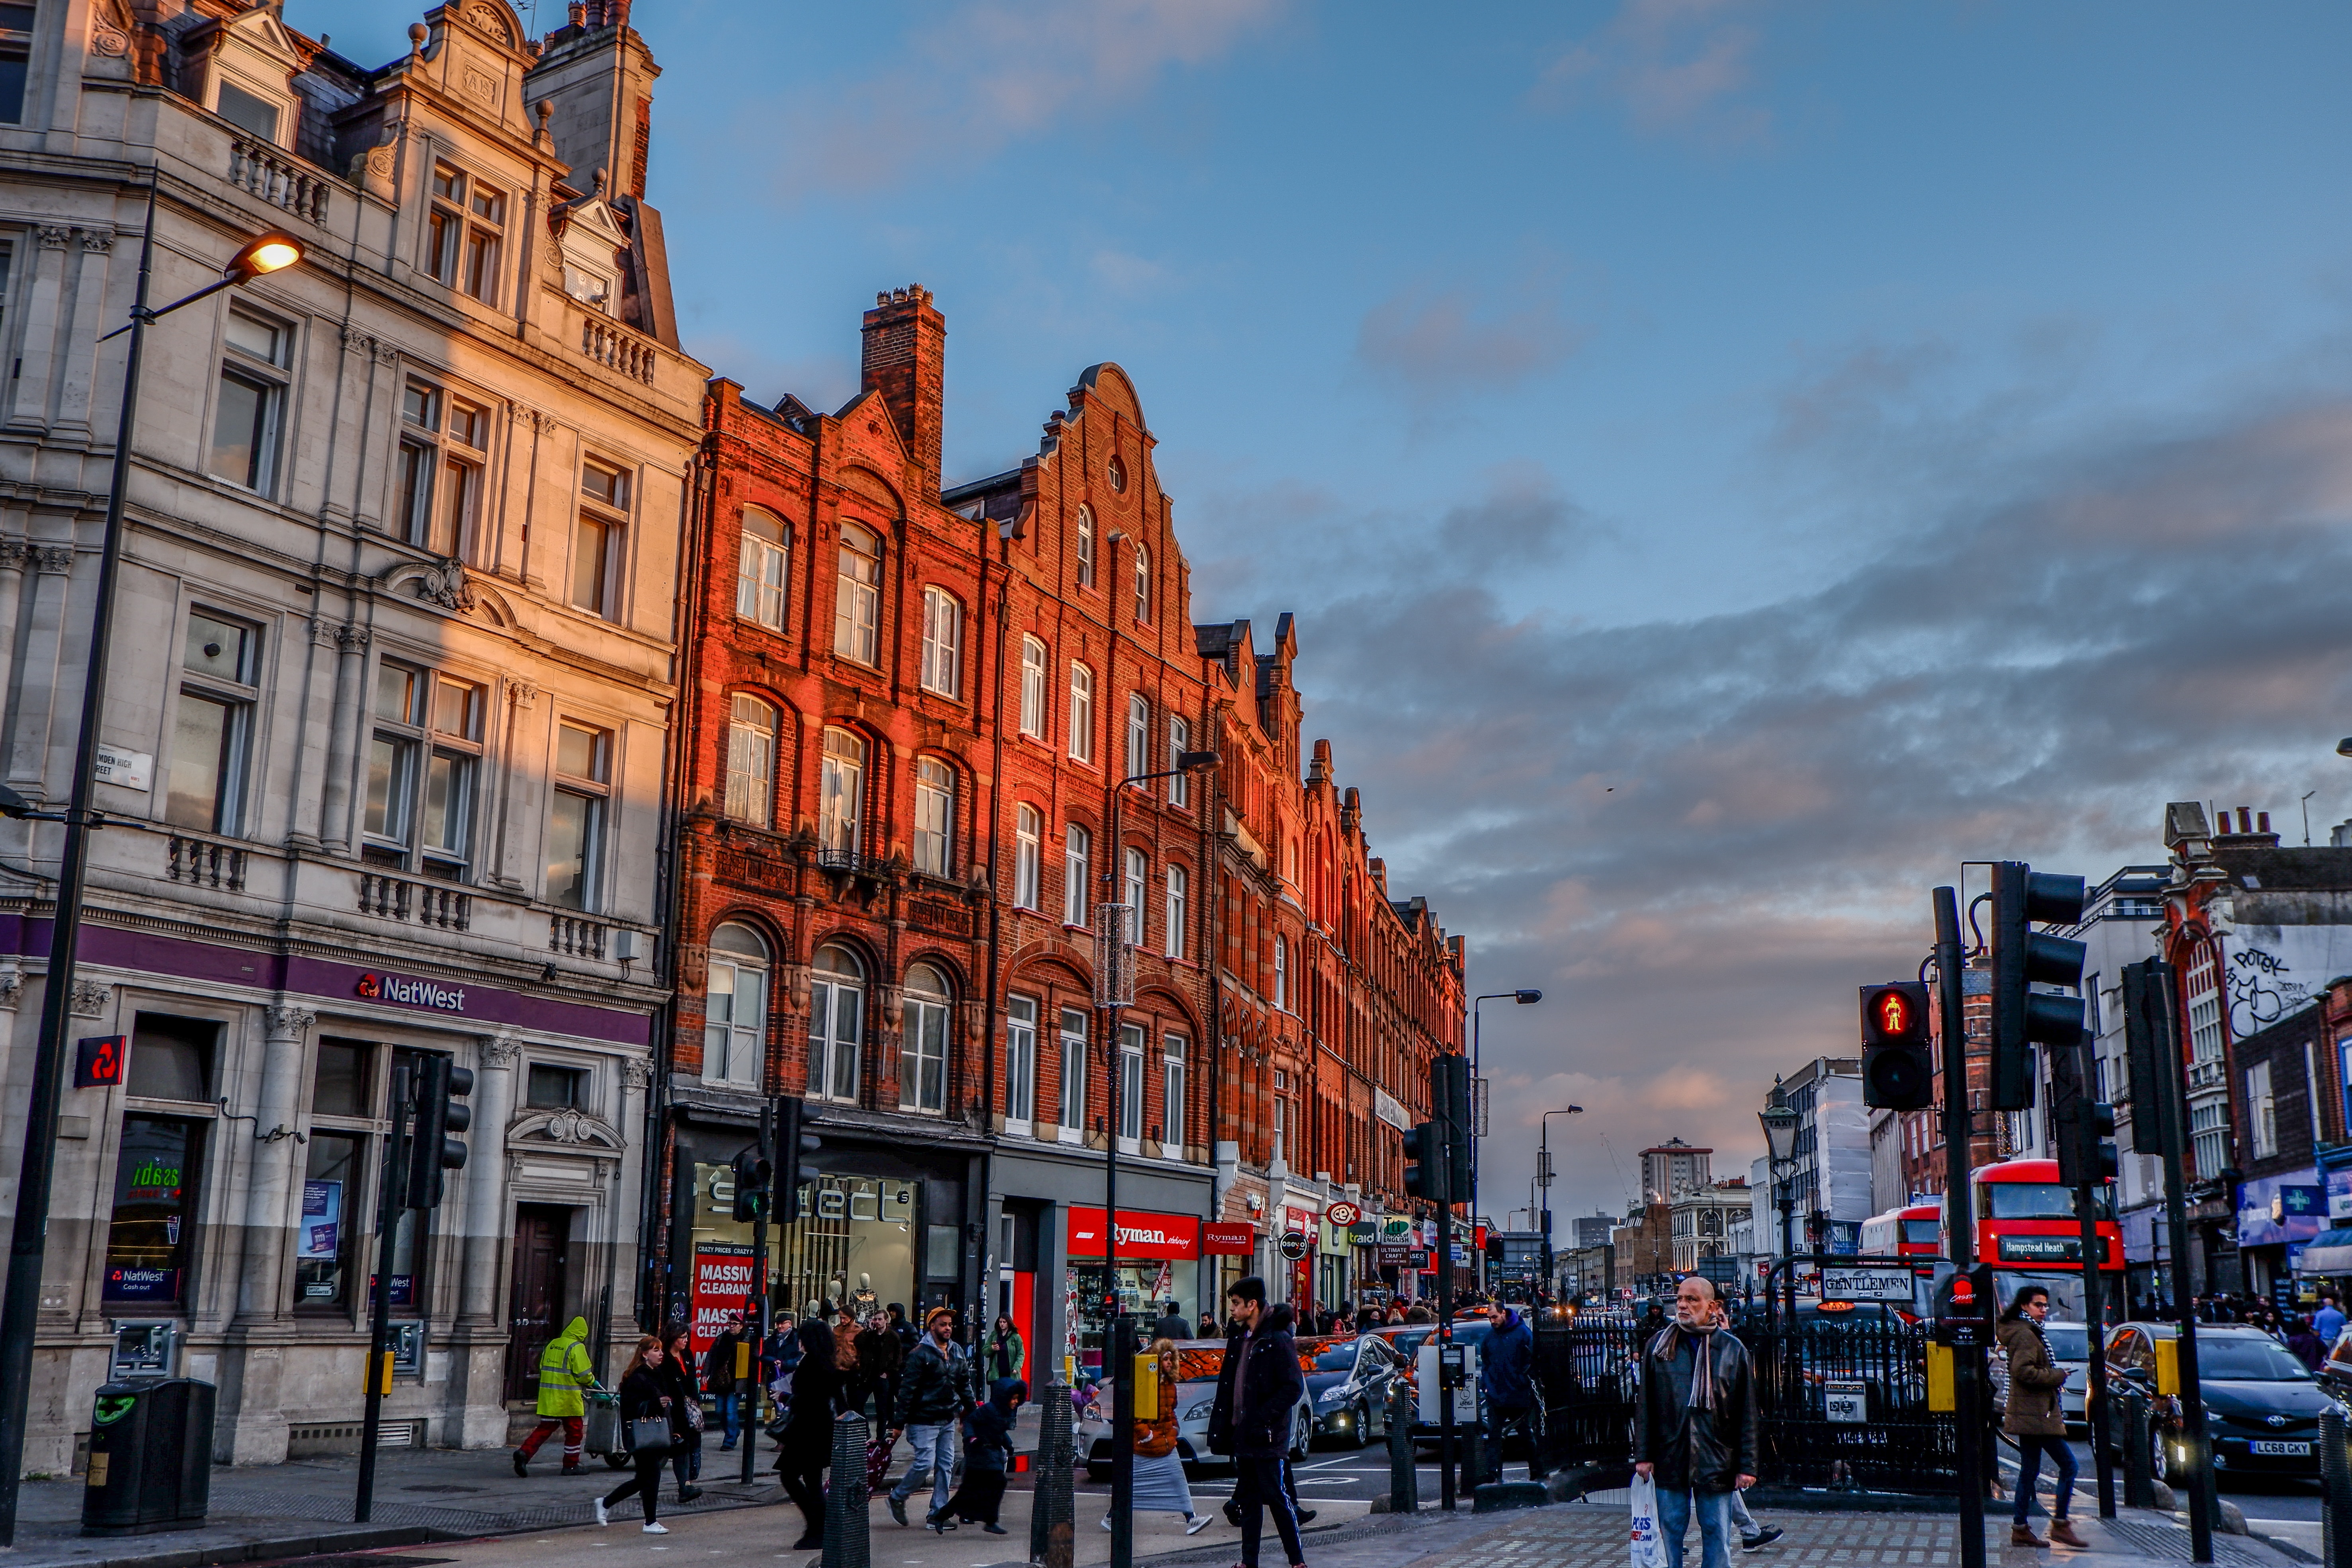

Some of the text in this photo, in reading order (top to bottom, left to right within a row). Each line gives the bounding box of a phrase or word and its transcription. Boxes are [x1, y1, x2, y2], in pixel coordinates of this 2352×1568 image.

[98, 754, 132, 769] MDEN HIGH
[96, 765, 112, 775] REET
[384, 976, 465, 1011] NatWest
[1349, 1232, 1374, 1243] traid
[1282, 1241, 1305, 1249] oseyo
[2006, 1242, 2064, 1254] Hampstead Heath
[124, 1271, 164, 1281] NatWest
[700, 1264, 753, 1281] MASSIV
[1158, 1261, 1167, 1282] DIARIES
[391, 1277, 410, 1287] West
[1825, 1277, 1909, 1291] GENTLEMEN
[699, 1282, 752, 1295] CLEARANC
[2257, 1443, 2307, 1453] LC68 GKY
[1632, 1517, 1651, 1531] PORTS
